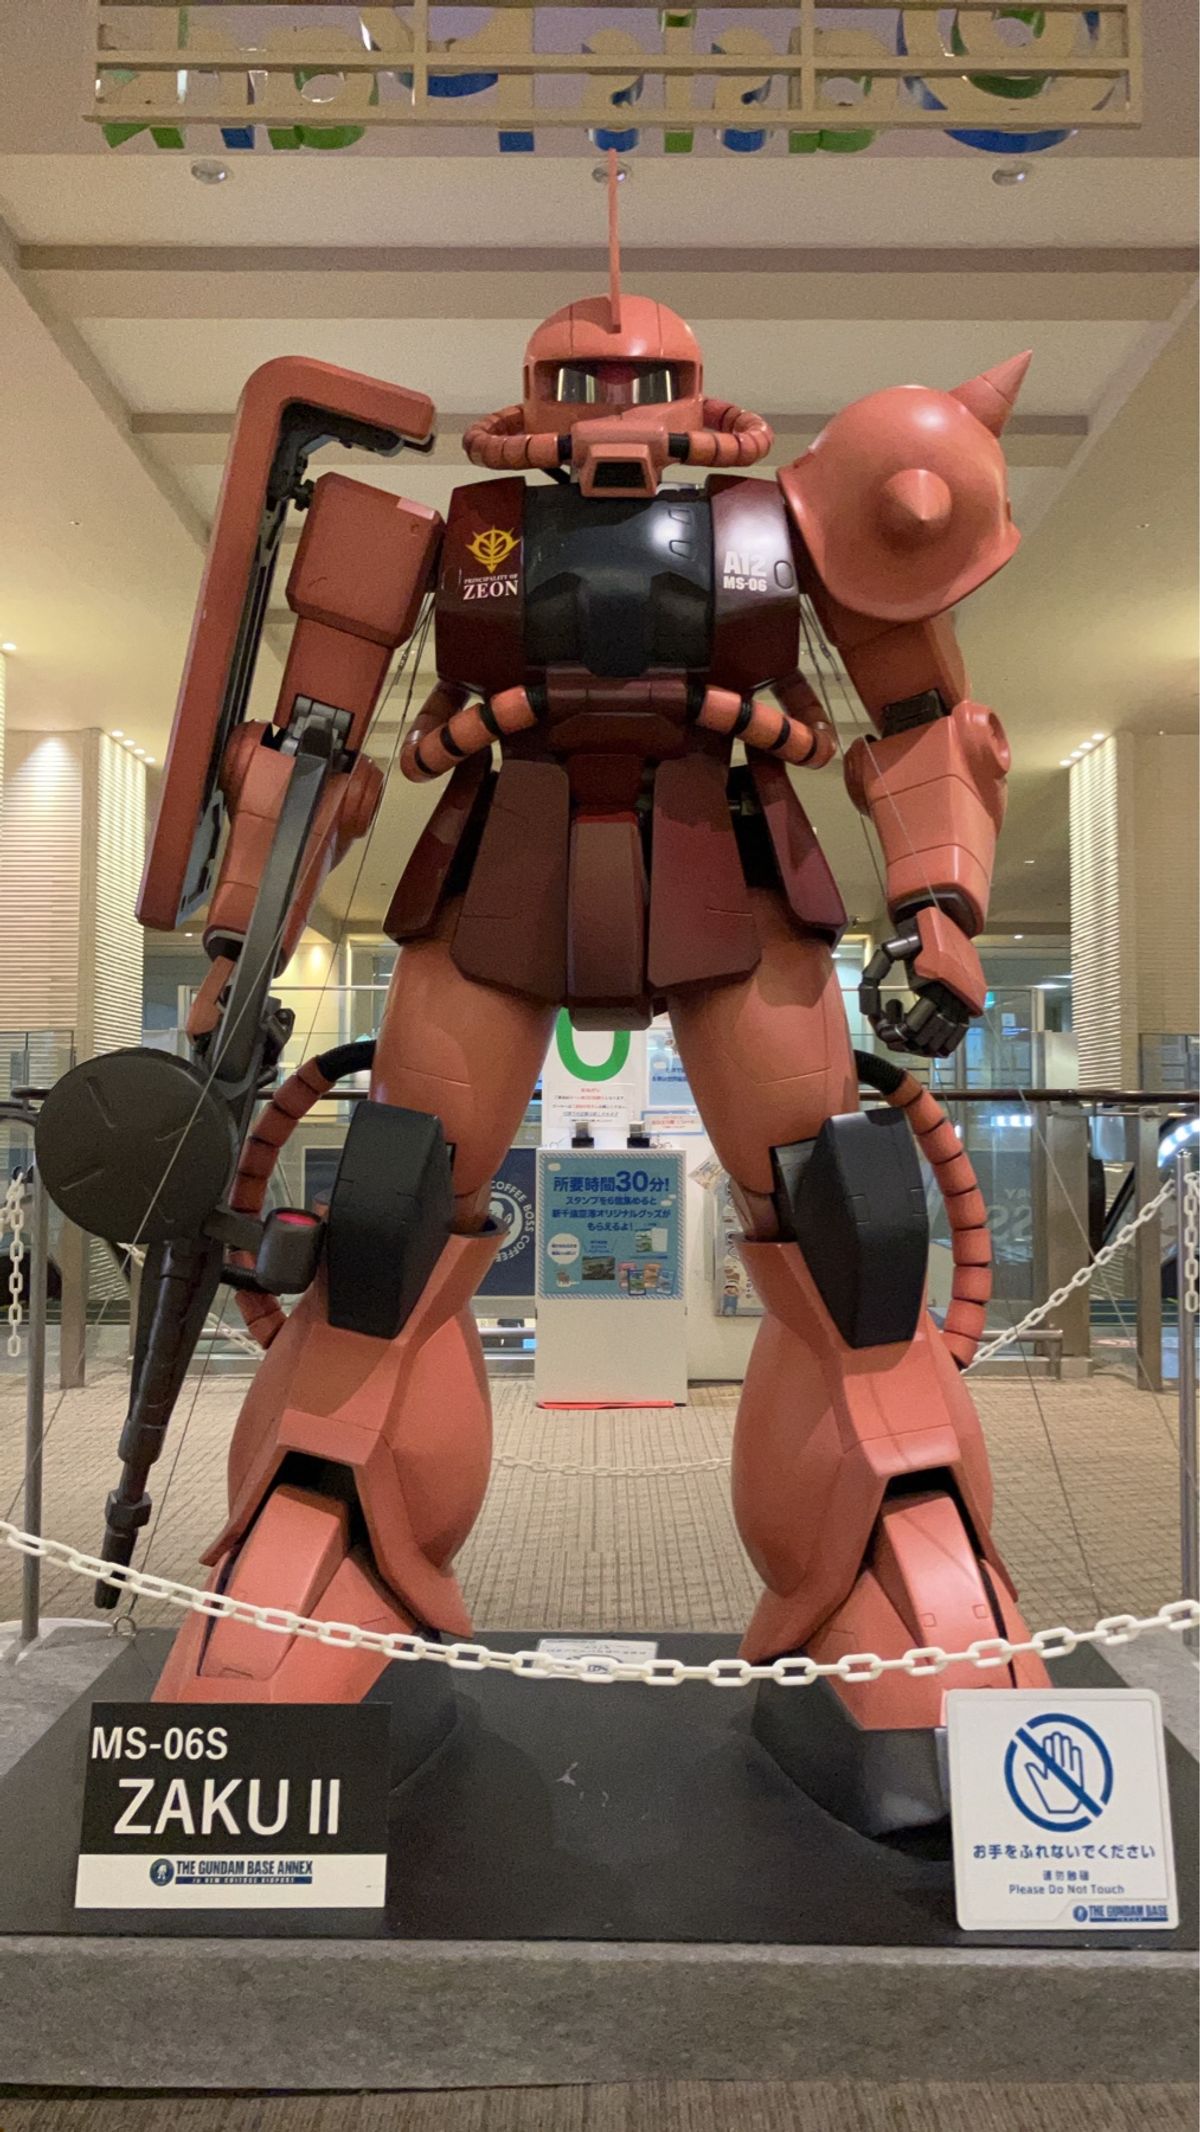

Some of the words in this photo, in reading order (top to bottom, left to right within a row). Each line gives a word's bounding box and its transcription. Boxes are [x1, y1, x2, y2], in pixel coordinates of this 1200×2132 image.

[723, 551, 767, 577] A12
[463, 580, 519, 600] ZEON
[723, 576, 767, 592] MS-06
[523, 1204, 535, 1232] BOSS
[91, 1726, 229, 1760] MS-06S
[113, 1778, 290, 1836] ZAKU
[973, 1845, 1156, 1860] お手をふれないでください
[176, 1860, 196, 1874] THE
[198, 1860, 245, 1874] GUNDAM
[247, 1861, 275, 1874] BASE
[277, 1861, 313, 1874] ANNEX
[1009, 1883, 1046, 1895] Please
[1049, 1884, 1064, 1895] Do
[1067, 1884, 1087, 1895] Not
[1091, 1883, 1125, 1895] Touch
[1088, 1905, 1104, 1917] THE
[1106, 1905, 1143, 1917] GUNDAM
[1146, 1905, 1168, 1917] BASE
